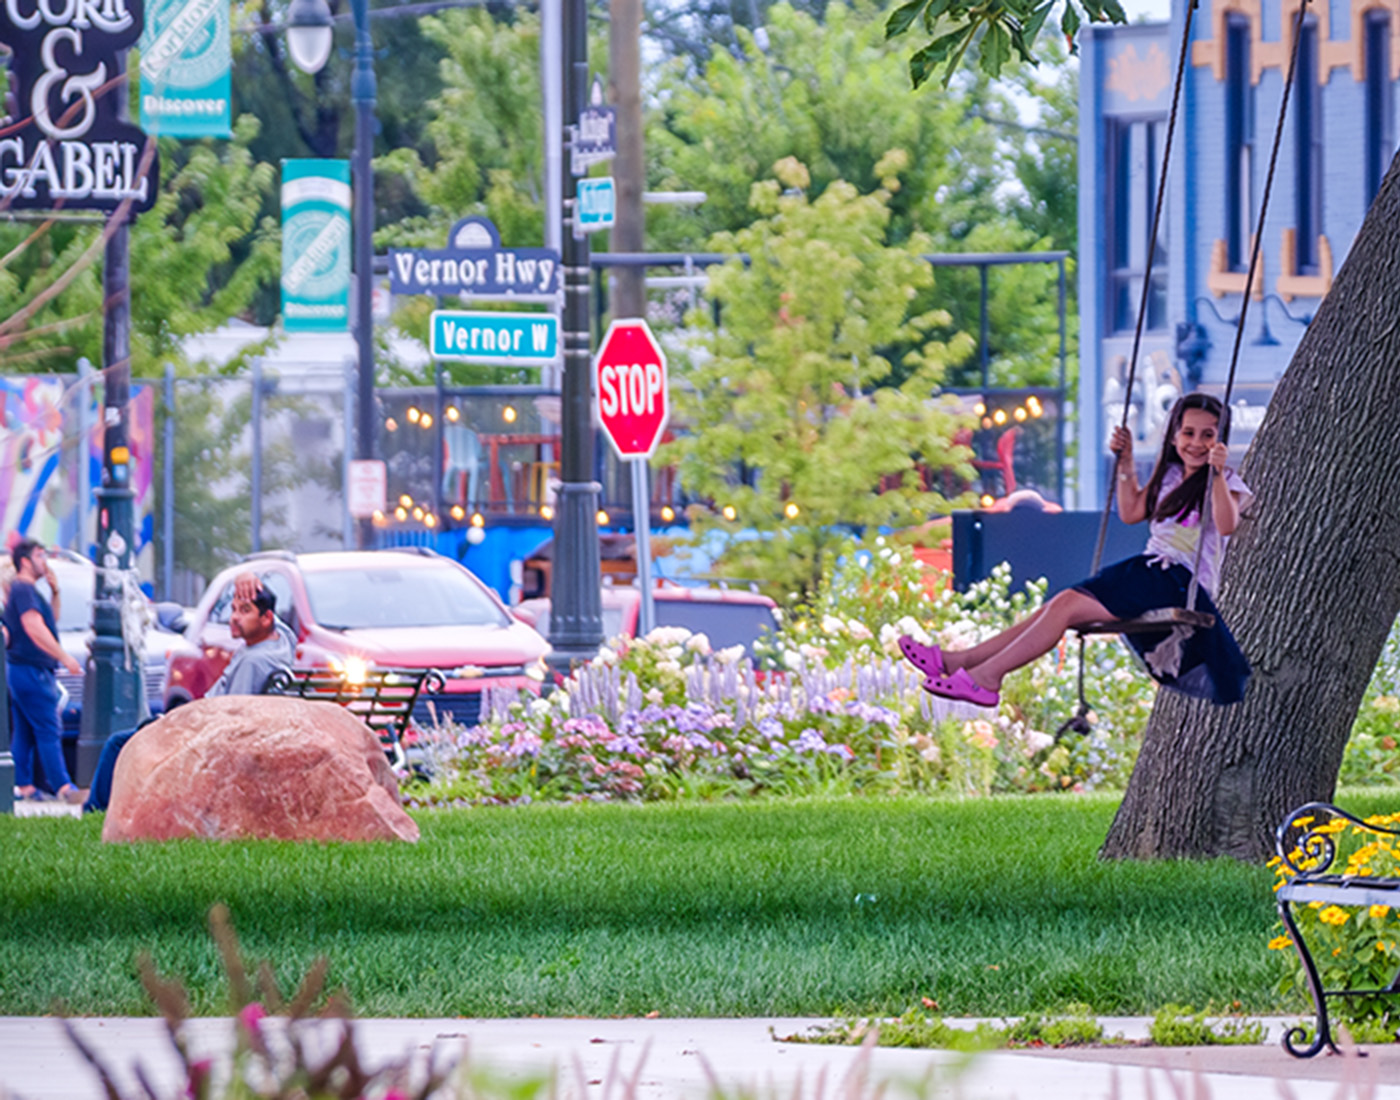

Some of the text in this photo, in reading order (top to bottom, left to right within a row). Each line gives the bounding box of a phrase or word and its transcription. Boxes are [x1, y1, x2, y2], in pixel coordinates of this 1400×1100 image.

[31, 27, 107, 139] &
[143, 95, 226, 116] Discover
[0, 136, 149, 202] GABEL
[395, 252, 554, 292] Vernor Hwy
[443, 320, 548, 351] Vernor W
[601, 363, 661, 417] STOP
